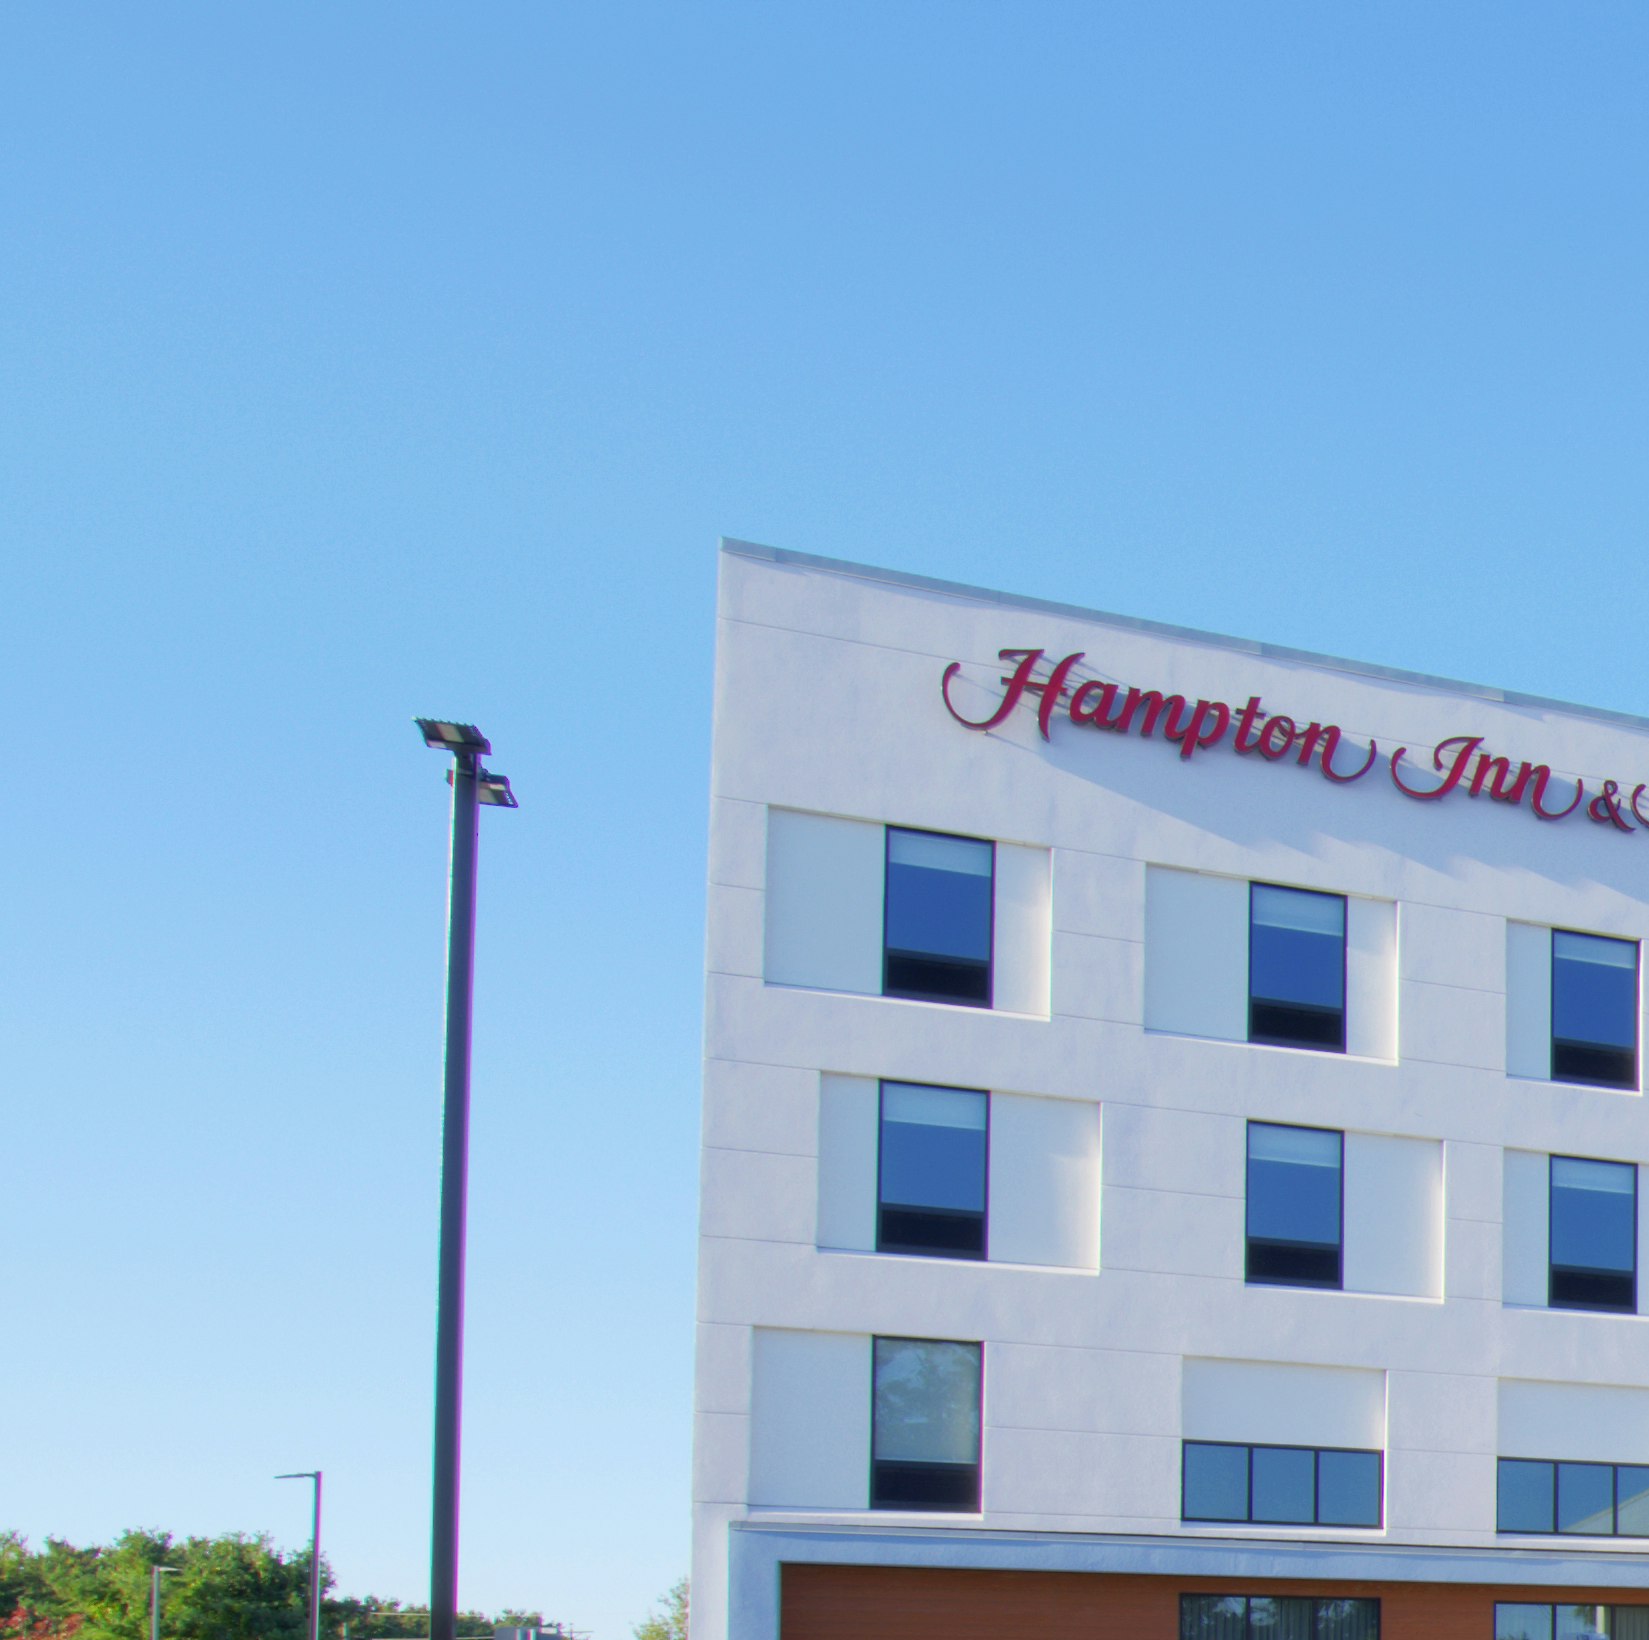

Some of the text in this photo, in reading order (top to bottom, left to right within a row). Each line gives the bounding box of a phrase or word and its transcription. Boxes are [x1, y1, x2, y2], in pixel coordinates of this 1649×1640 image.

[940, 648, 1378, 784] Hampton
[1389, 736, 1584, 822] Inn
[1586, 779, 1637, 833] &
